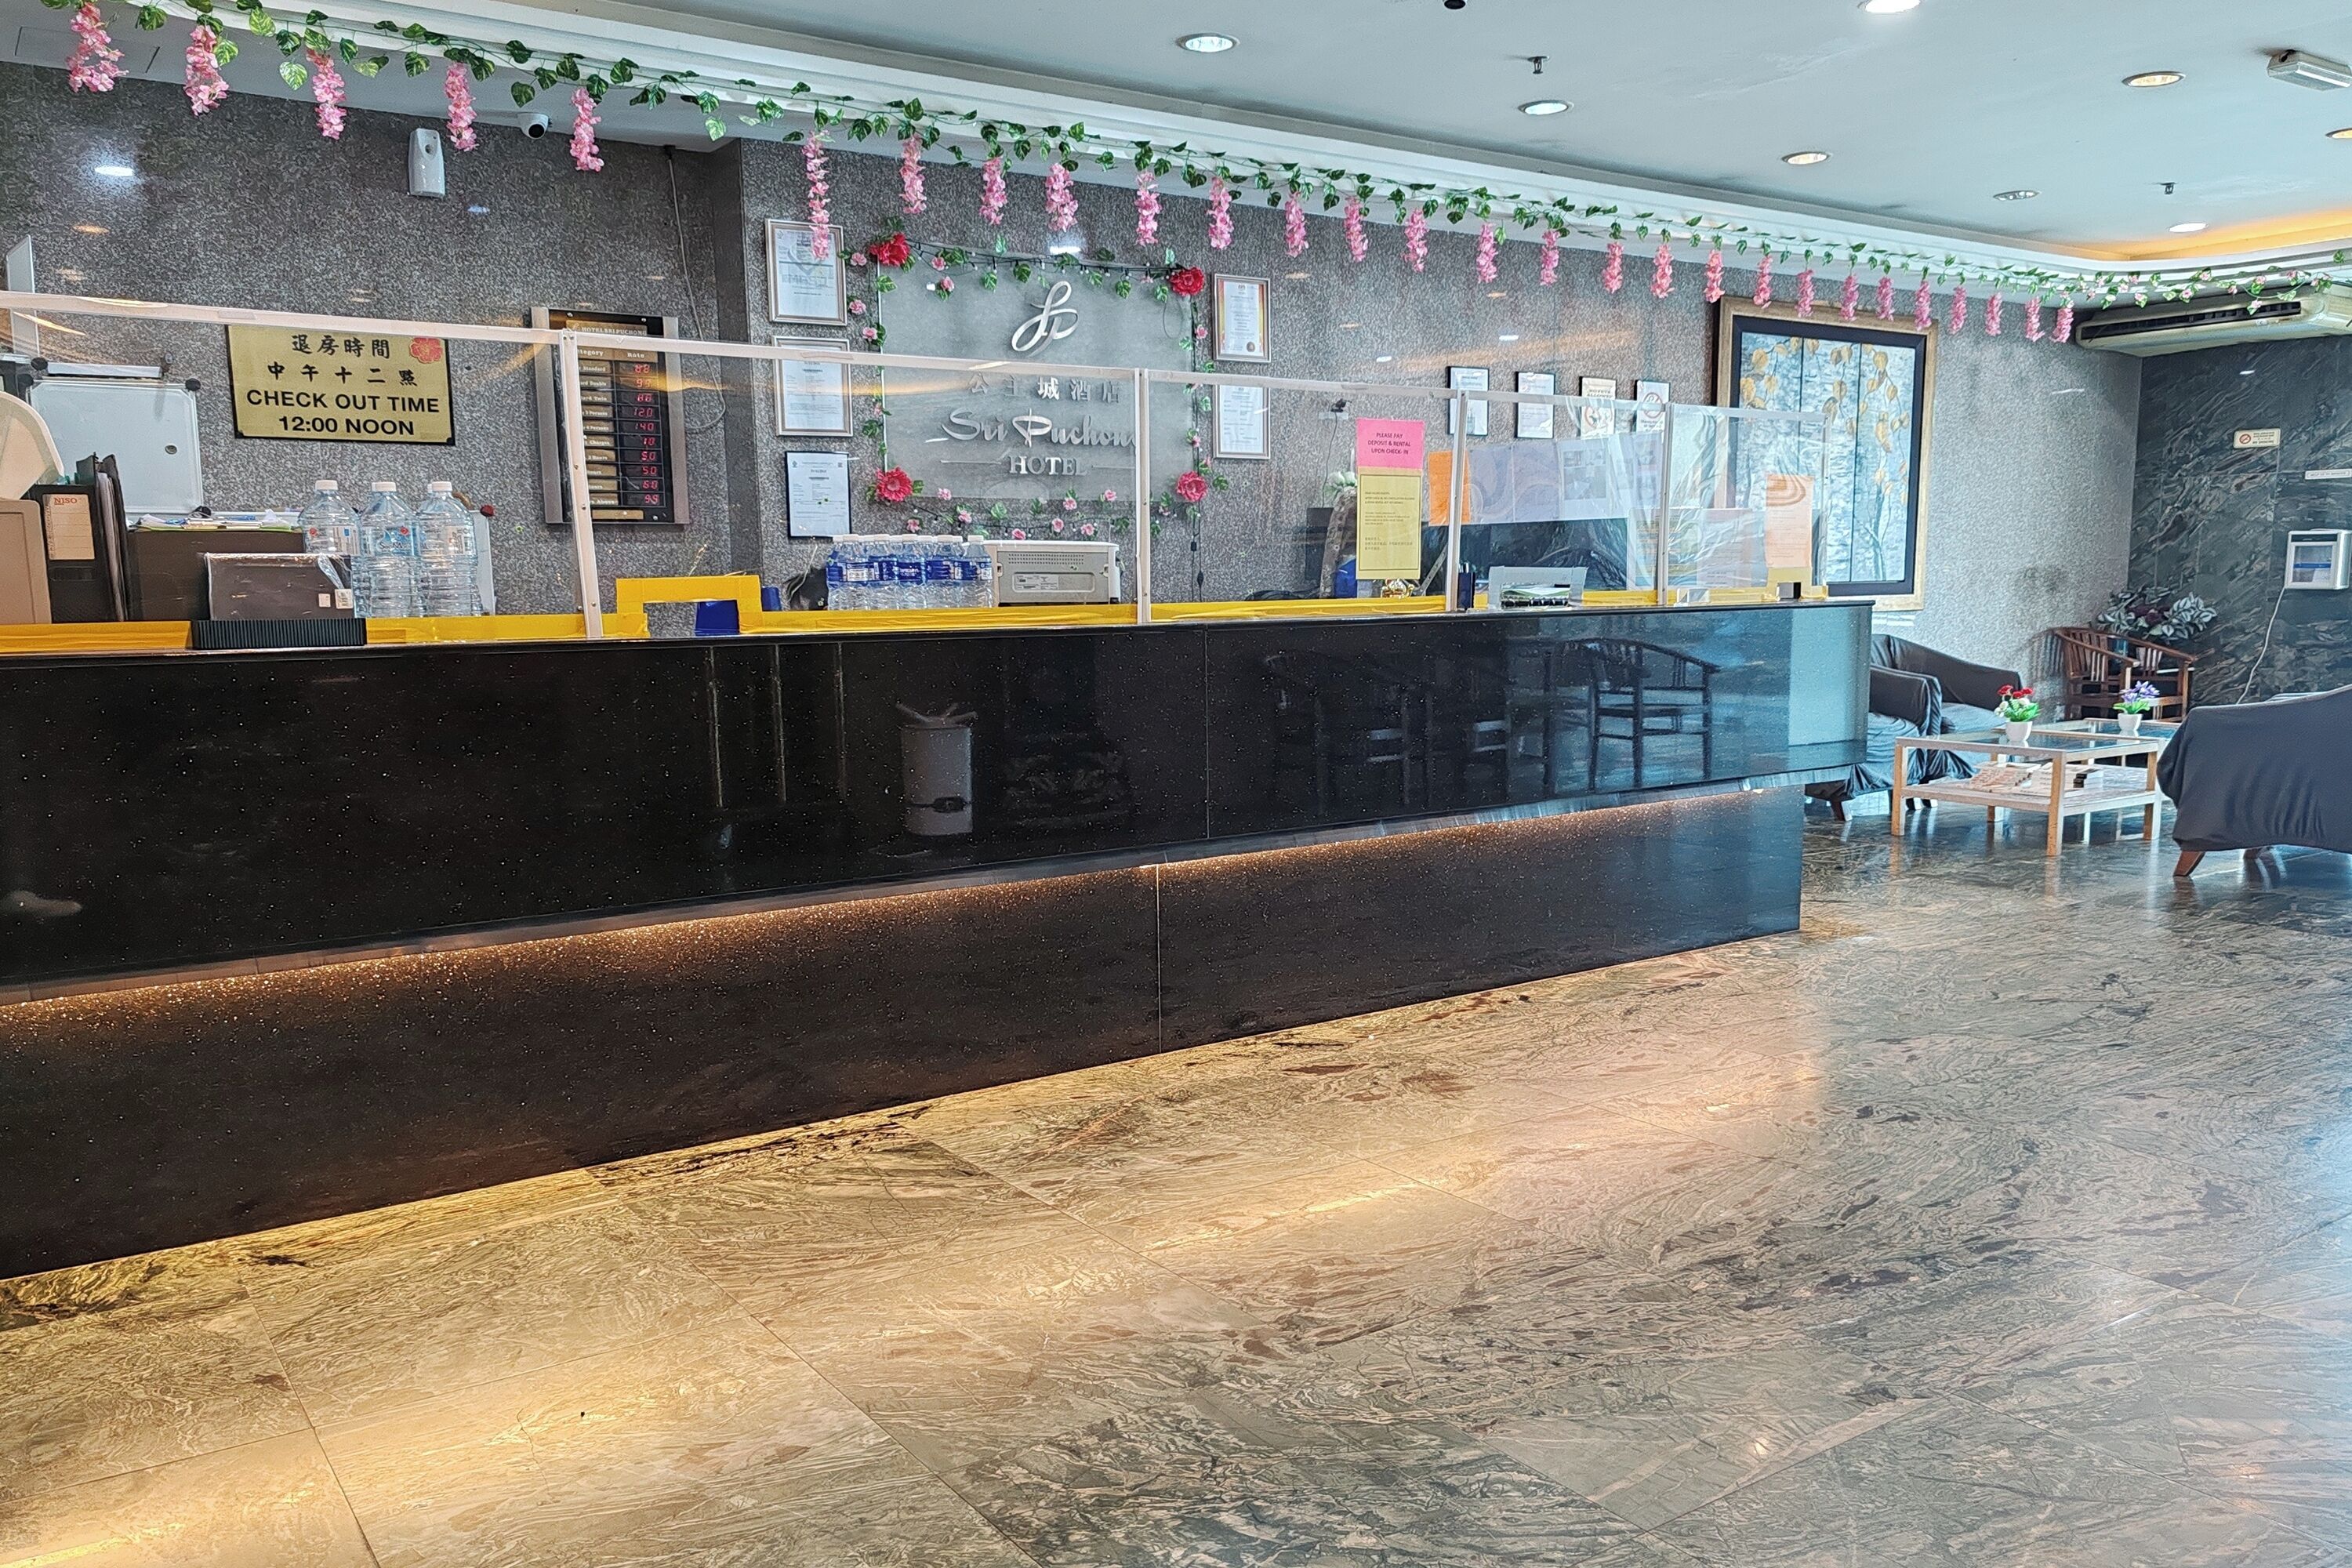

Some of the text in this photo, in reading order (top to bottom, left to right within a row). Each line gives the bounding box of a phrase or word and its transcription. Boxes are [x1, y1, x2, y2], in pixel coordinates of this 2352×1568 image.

[292, 334, 390, 360] 退房時間
[247, 390, 440, 413] CHECK OUT TIME
[633, 408, 654, 417] 120
[279, 416, 415, 436] 12:00 NOON
[635, 423, 655, 432] 140
[941, 407, 1136, 452] Sri Puchon
[641, 451, 656, 461] 50
[1008, 455, 1089, 477] HOTEL
[642, 466, 657, 475] 50
